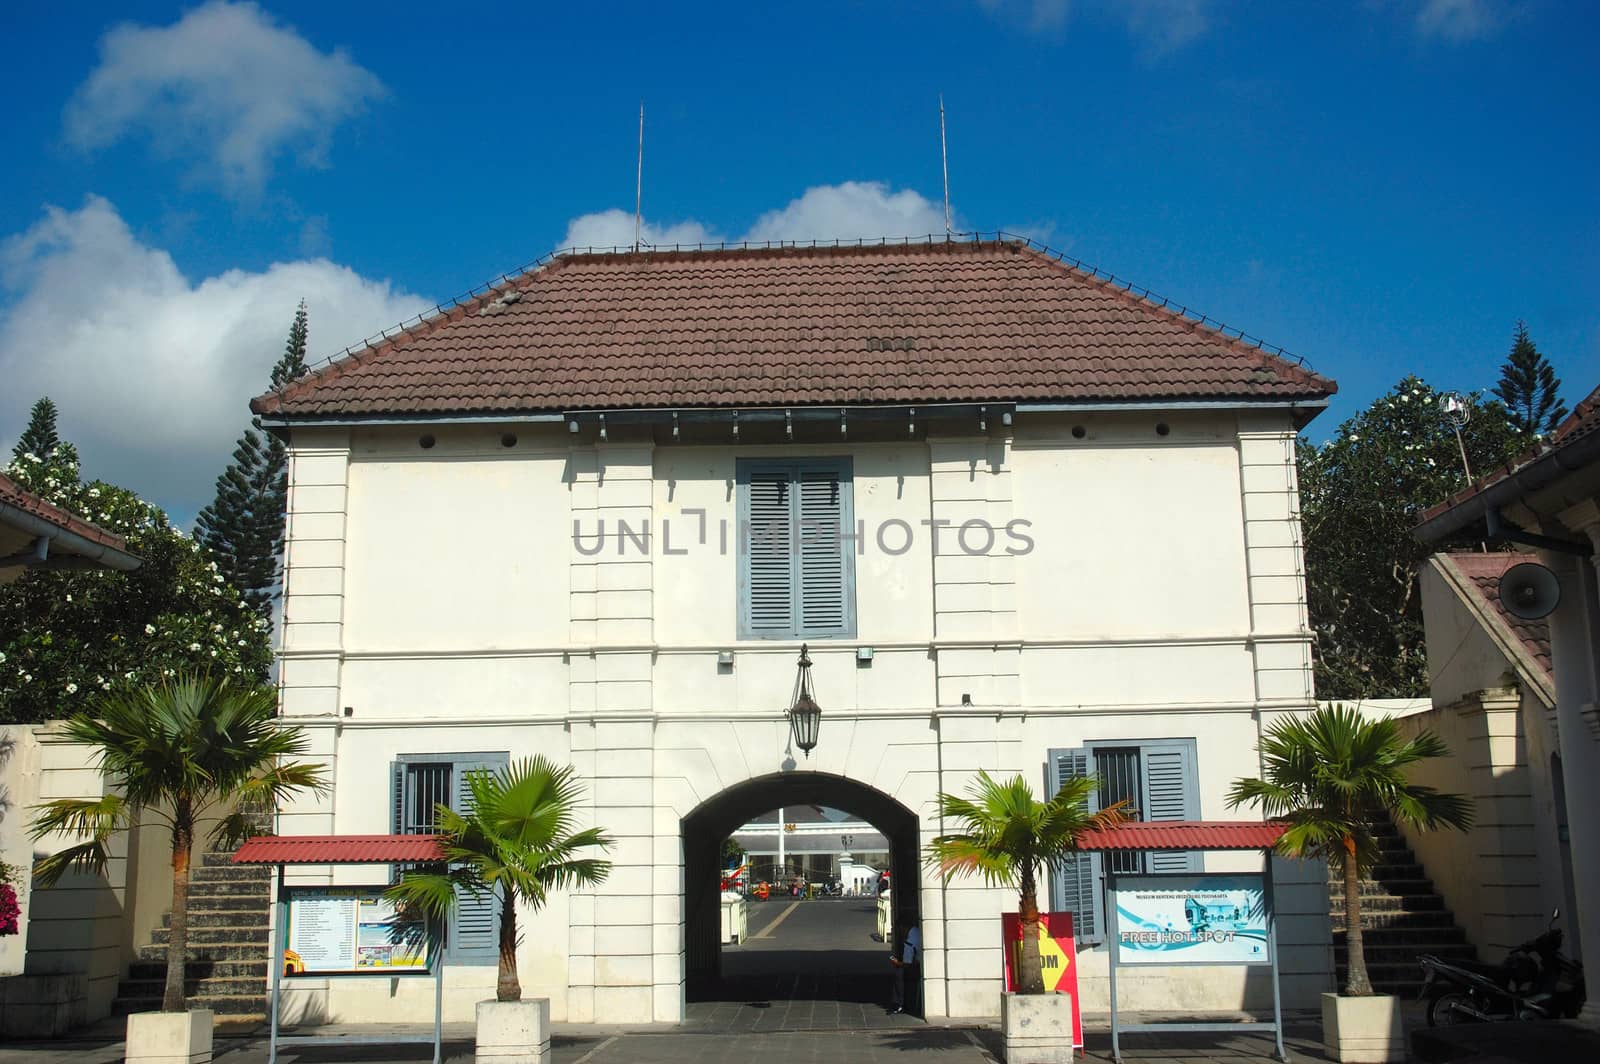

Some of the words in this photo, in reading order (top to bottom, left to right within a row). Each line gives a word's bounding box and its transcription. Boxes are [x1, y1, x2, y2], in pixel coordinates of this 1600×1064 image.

[1121, 931, 1158, 943] FREE
[1160, 931, 1193, 943] HOT
[1196, 930, 1236, 943] SPOT
